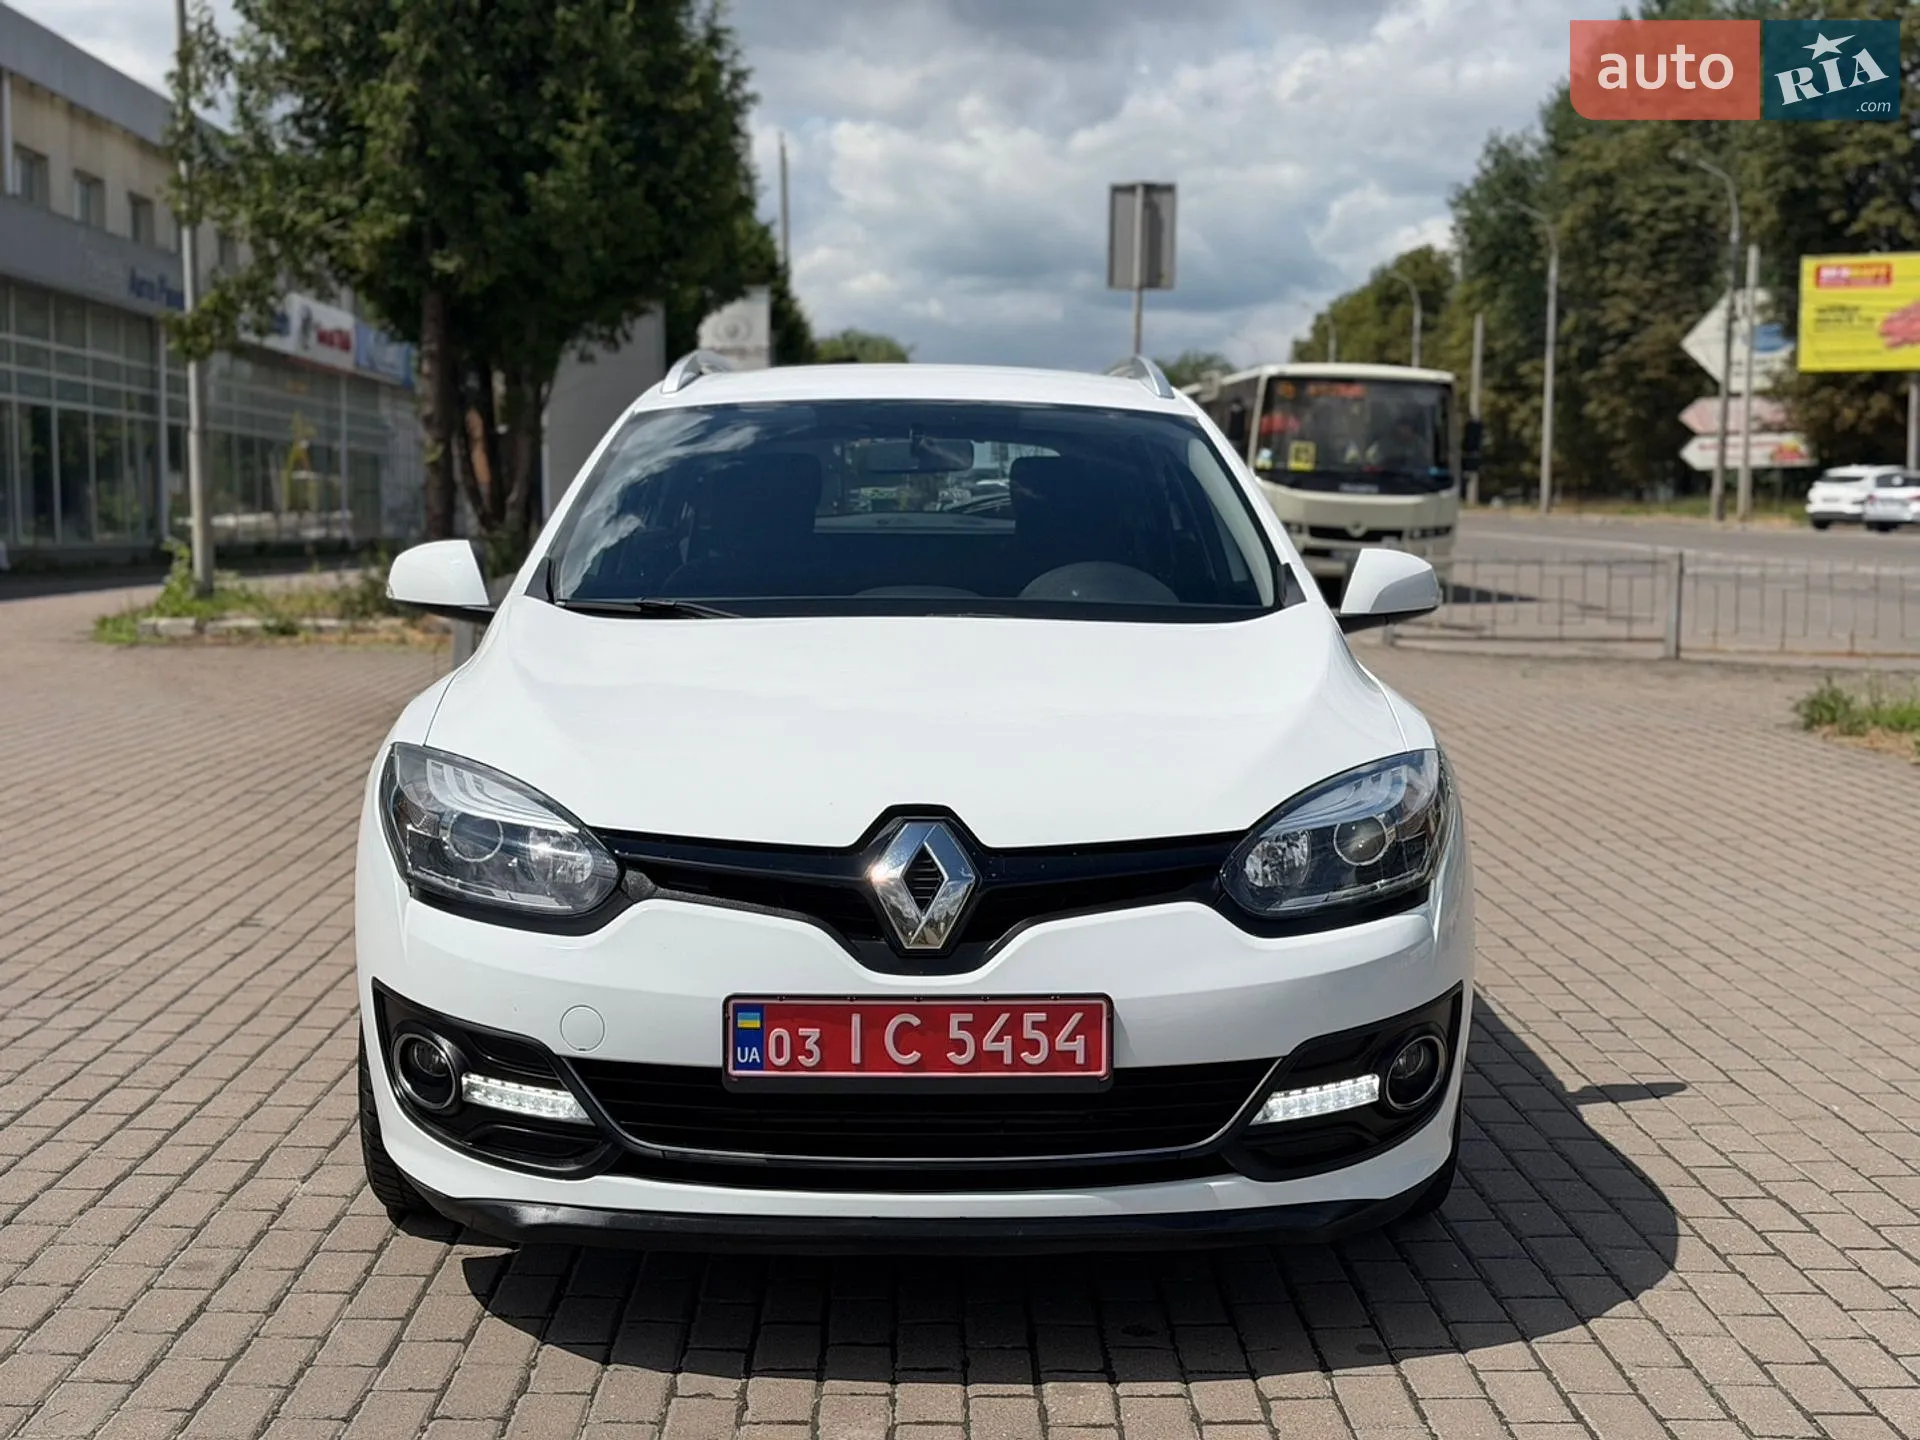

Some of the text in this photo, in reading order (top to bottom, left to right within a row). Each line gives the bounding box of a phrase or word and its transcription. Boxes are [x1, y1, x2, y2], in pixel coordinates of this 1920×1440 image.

[737, 1047, 761, 1063] UA
[768, 1028, 821, 1066] 03
[946, 1012, 1085, 1065] 5454
